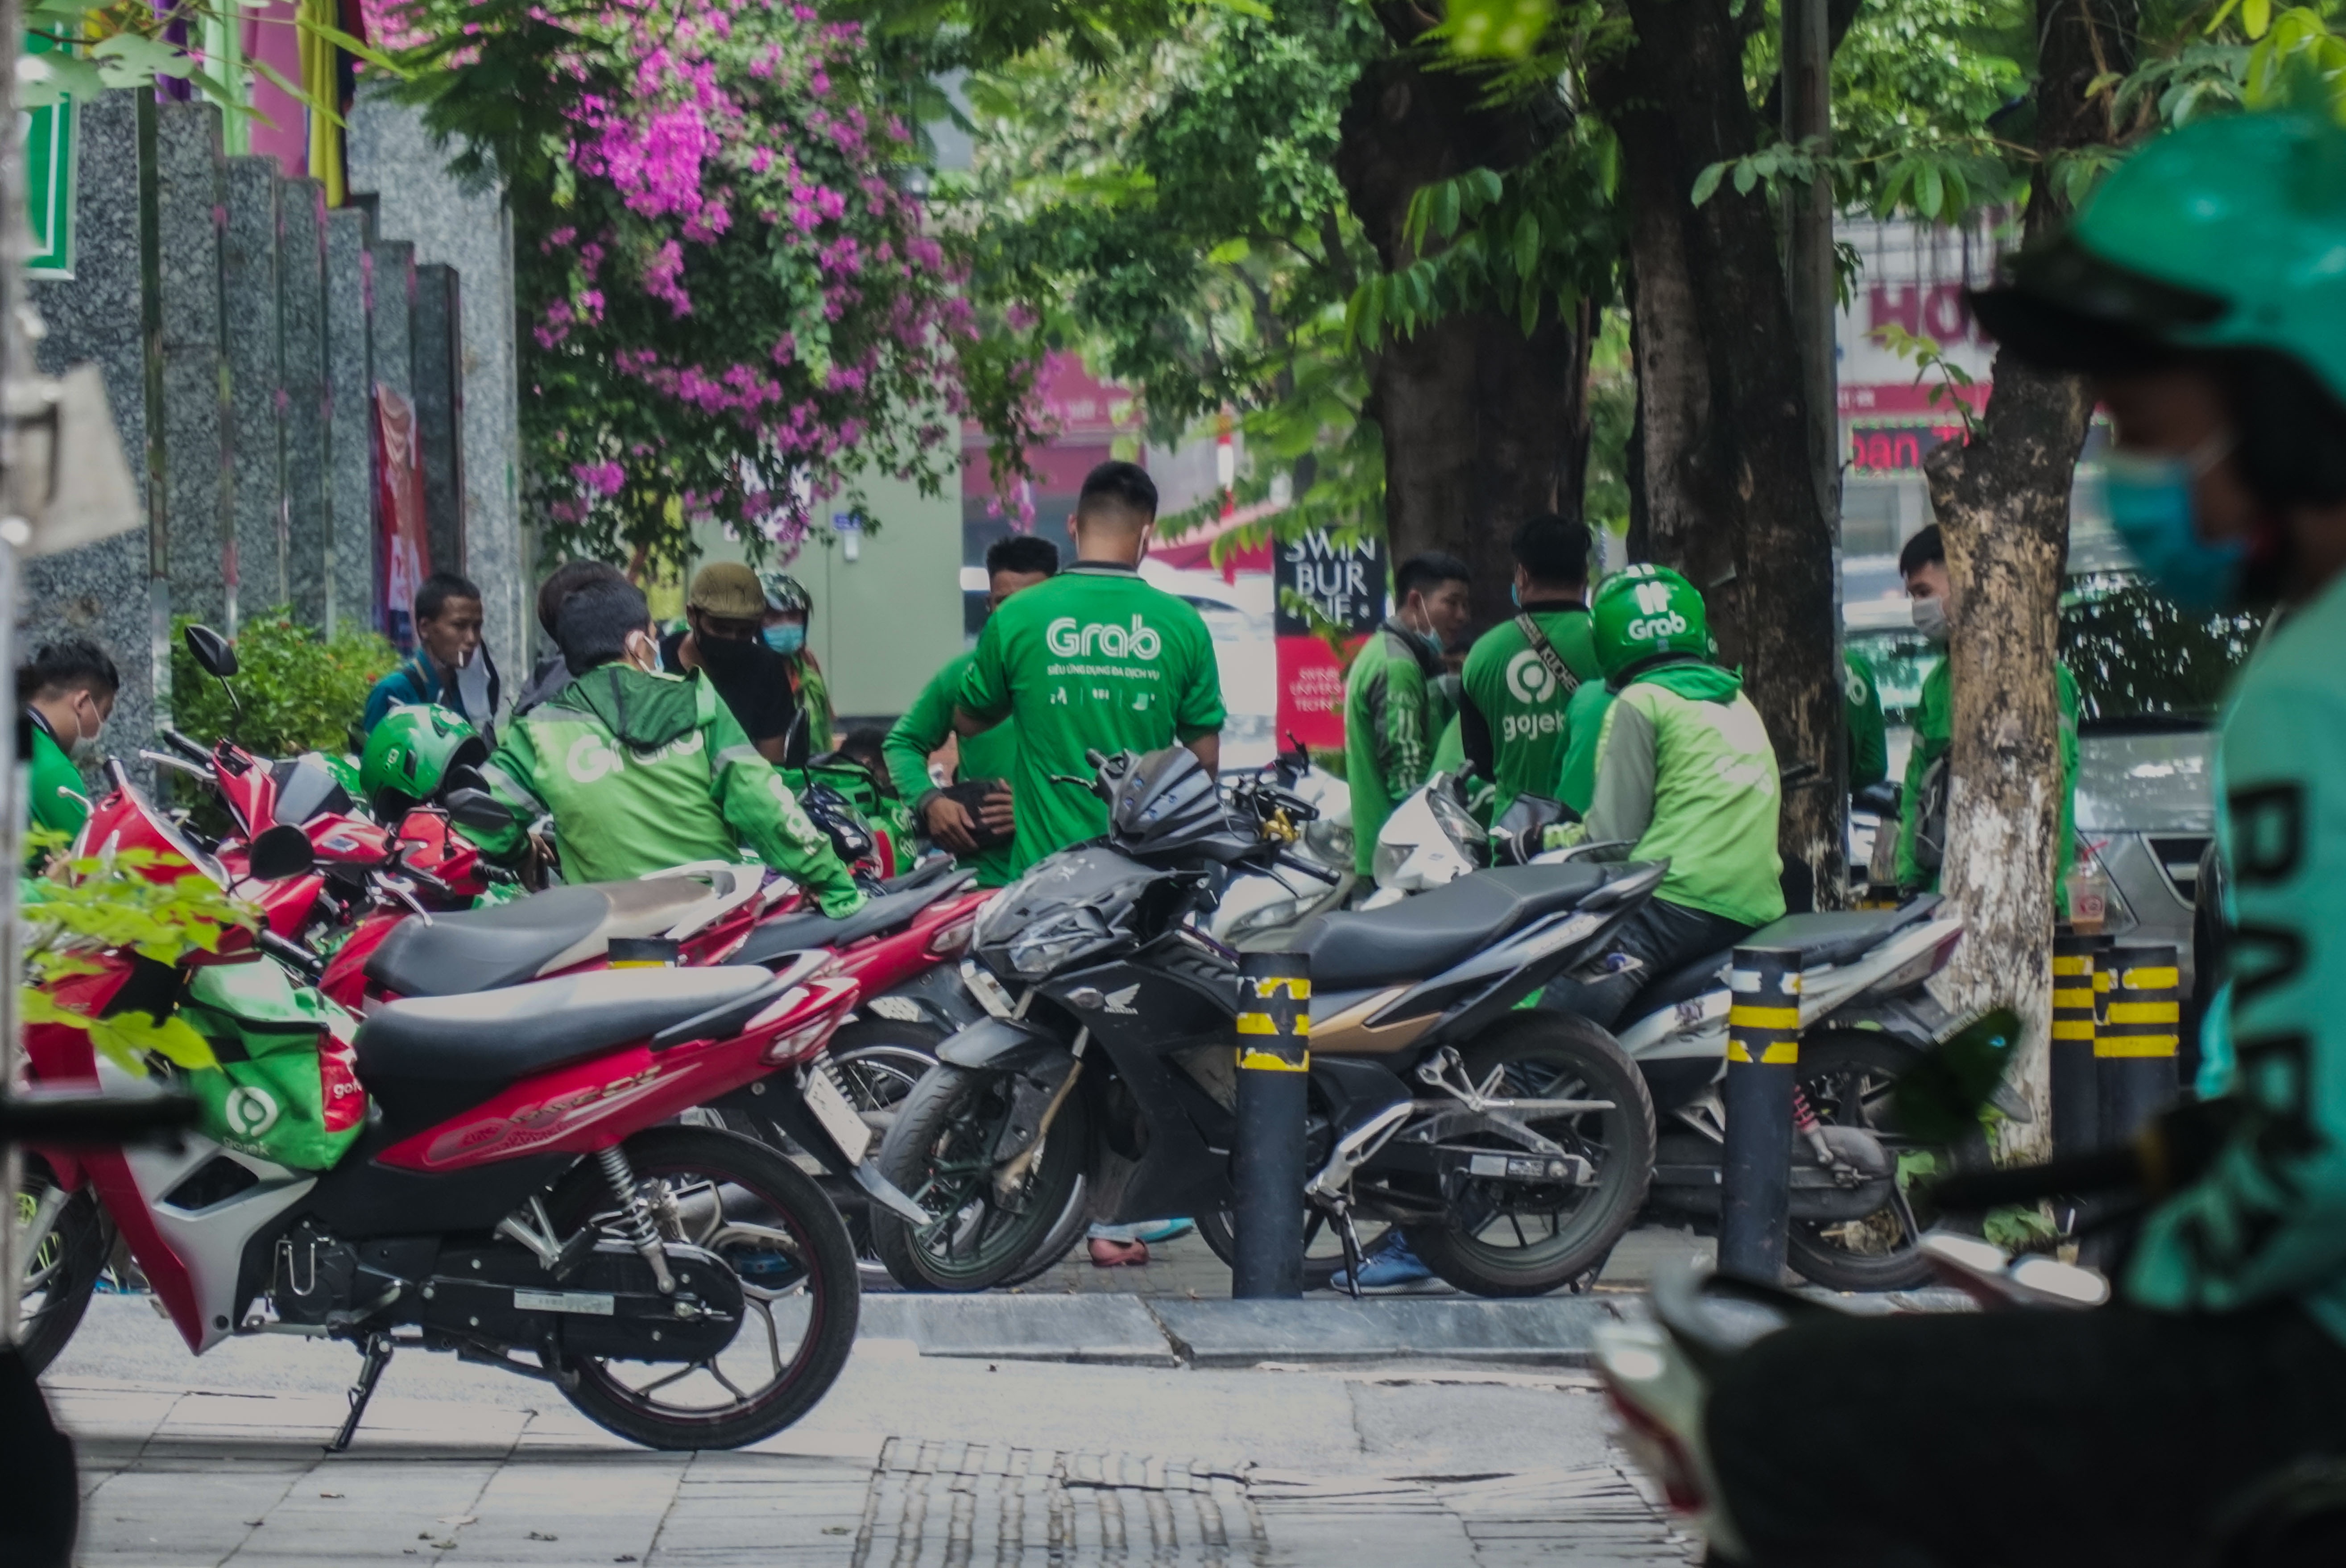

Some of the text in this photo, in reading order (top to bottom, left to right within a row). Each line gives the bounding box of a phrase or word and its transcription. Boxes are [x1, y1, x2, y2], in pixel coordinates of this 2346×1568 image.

[1296, 561, 1369, 597] BUR
[1047, 614, 1161, 660] Grab
[1629, 610, 1686, 640] Grab
[1502, 709, 1566, 743] gojek
